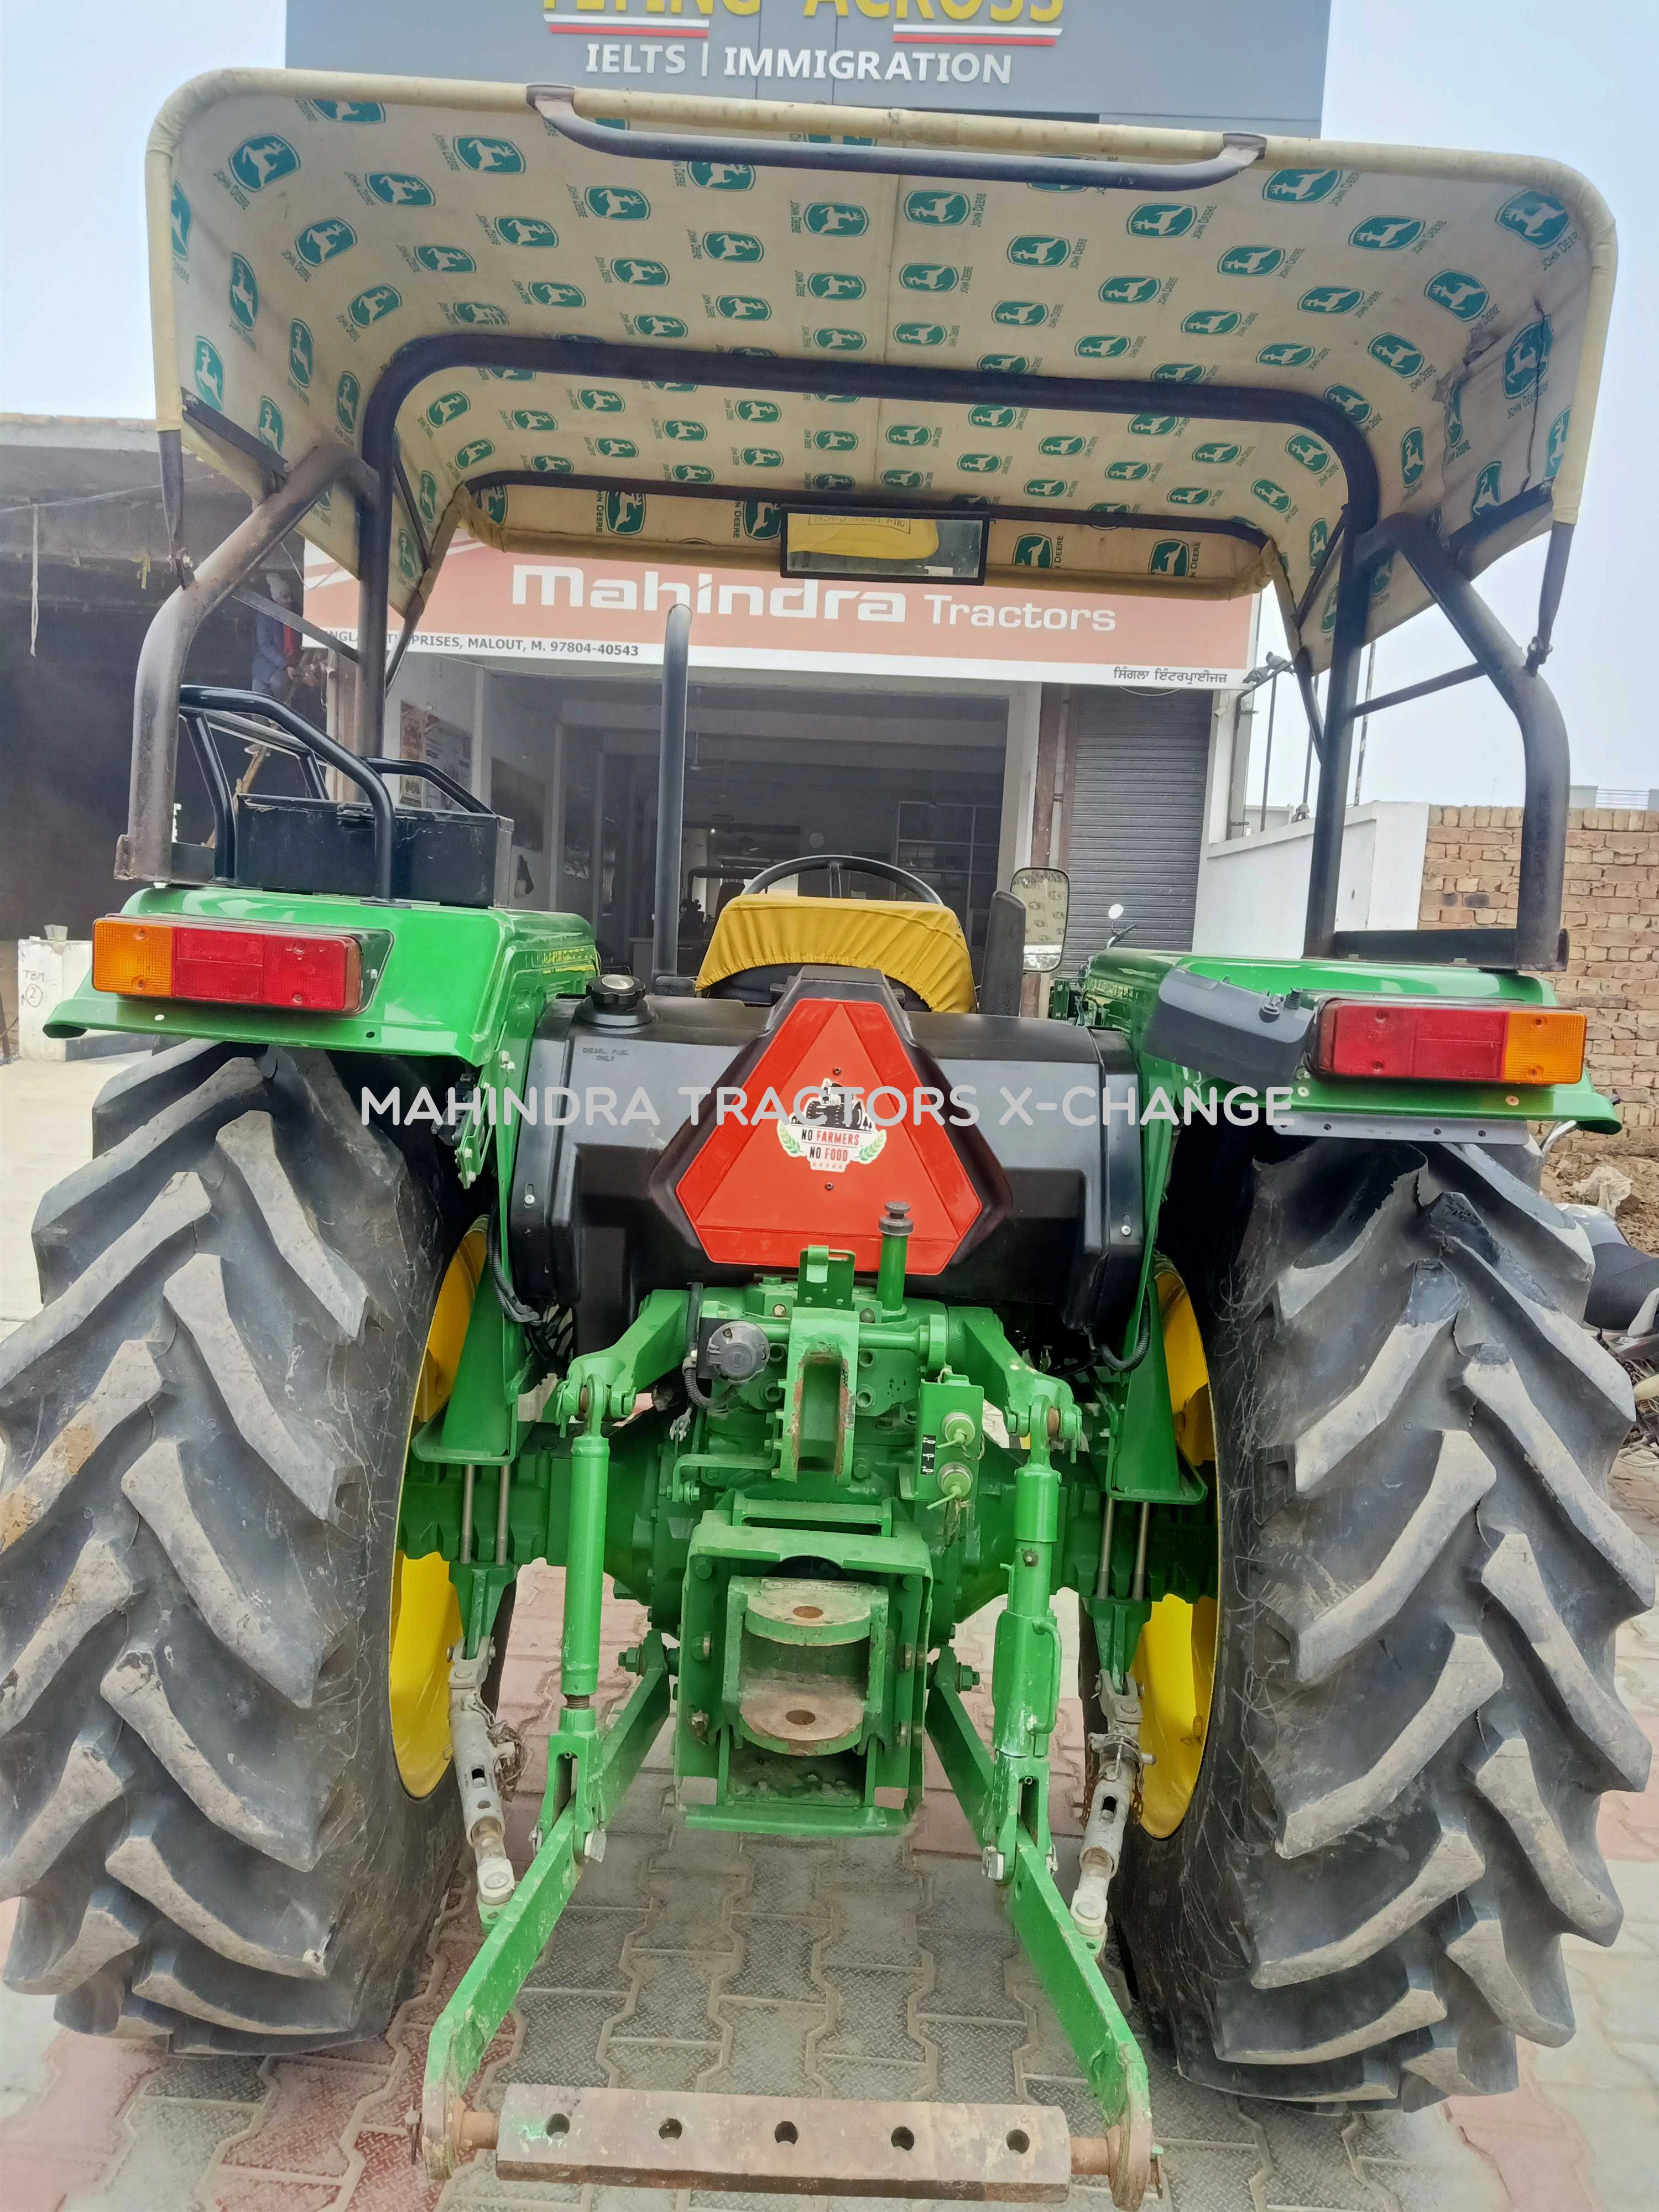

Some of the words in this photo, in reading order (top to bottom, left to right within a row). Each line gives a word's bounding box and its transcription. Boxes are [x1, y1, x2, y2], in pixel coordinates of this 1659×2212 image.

[586, 43, 686, 74] IELTS
[723, 47, 1012, 84] IMMIGRATION
[733, 510, 742, 539] DEERE
[1054, 535, 1064, 564] DEERE
[1190, 541, 1201, 569] DEERE
[924, 594, 1116, 632] Tractors
[467, 638, 526, 653] MALOUT,
[531, 640, 546, 652] M.
[550, 641, 639, 657] 97804-40543
[1113, 666, 1150, 680] ਸਿੰਗਲਾ
[801, 1129, 813, 1141] NO
[816, 1130, 860, 1146] FARMERS
[810, 1146, 821, 1159] NO
[825, 1148, 848, 1161] FOOD
